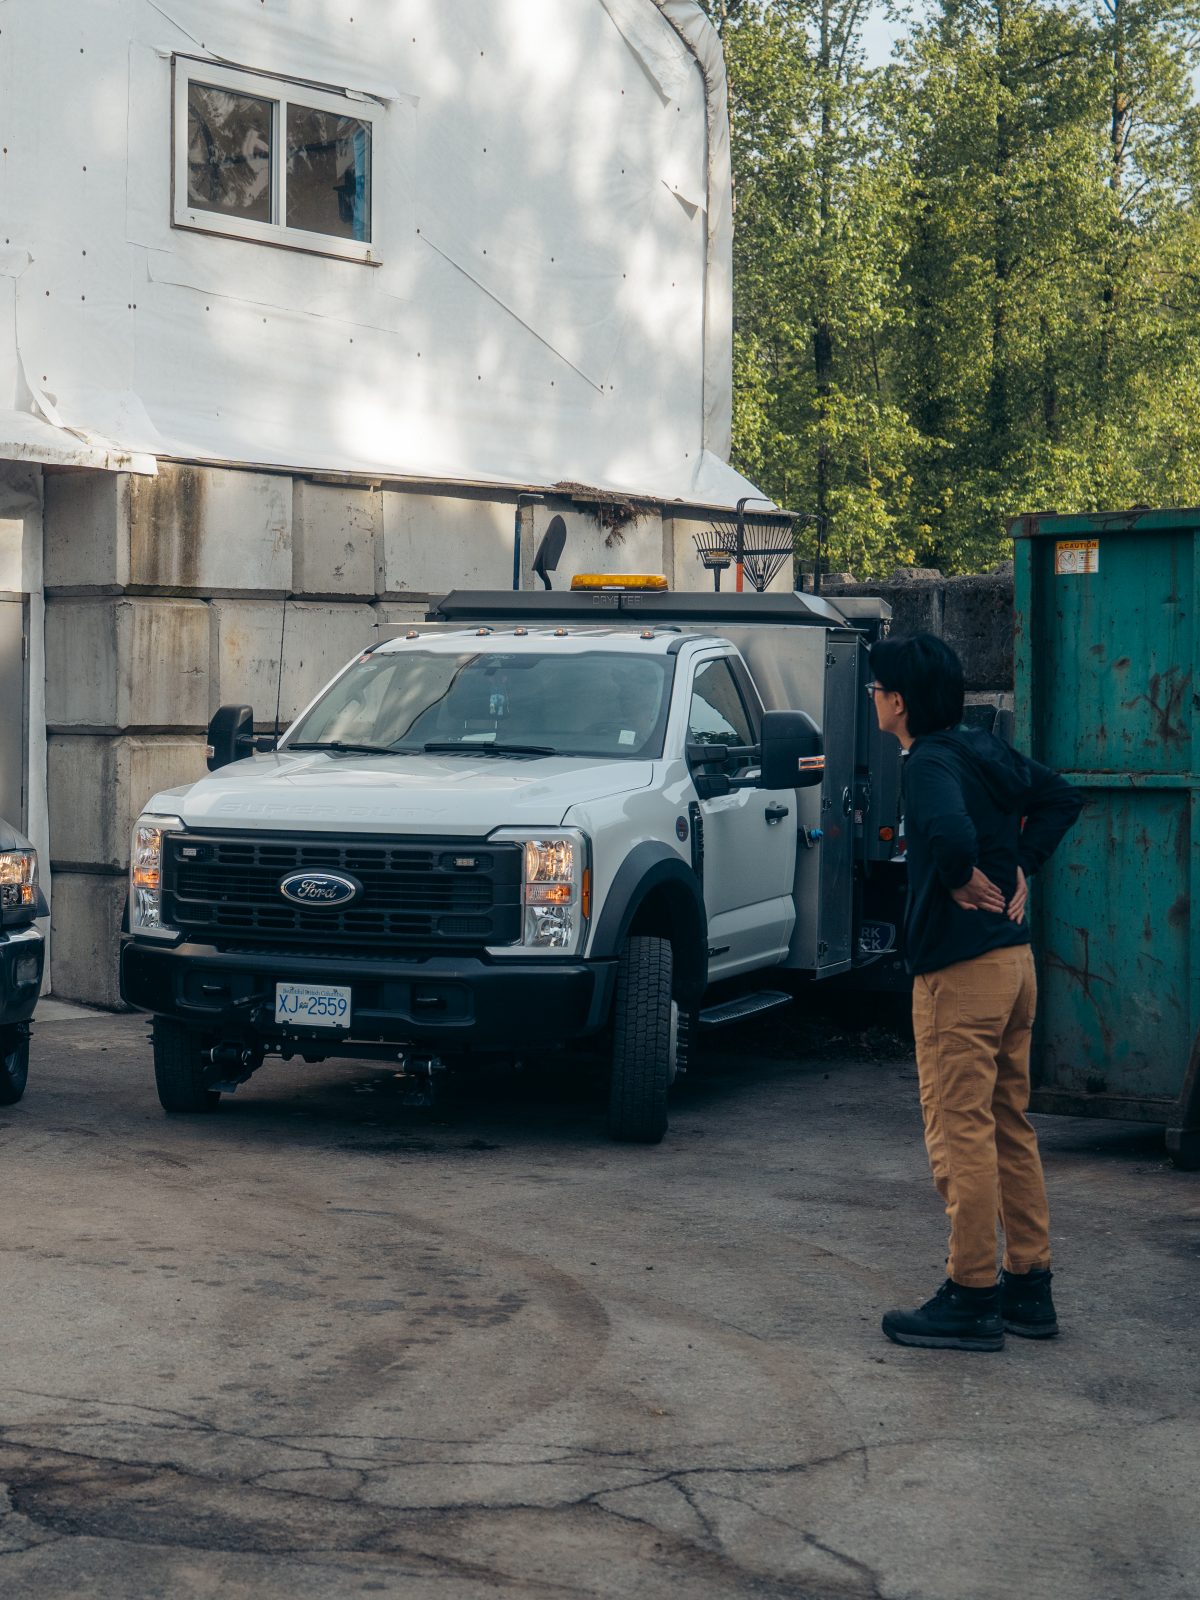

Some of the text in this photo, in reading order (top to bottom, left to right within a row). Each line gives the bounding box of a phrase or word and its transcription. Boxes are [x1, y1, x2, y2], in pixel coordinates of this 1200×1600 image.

[297, 879, 337, 899] Ford
[278, 994, 347, 1016] XJ 2559
